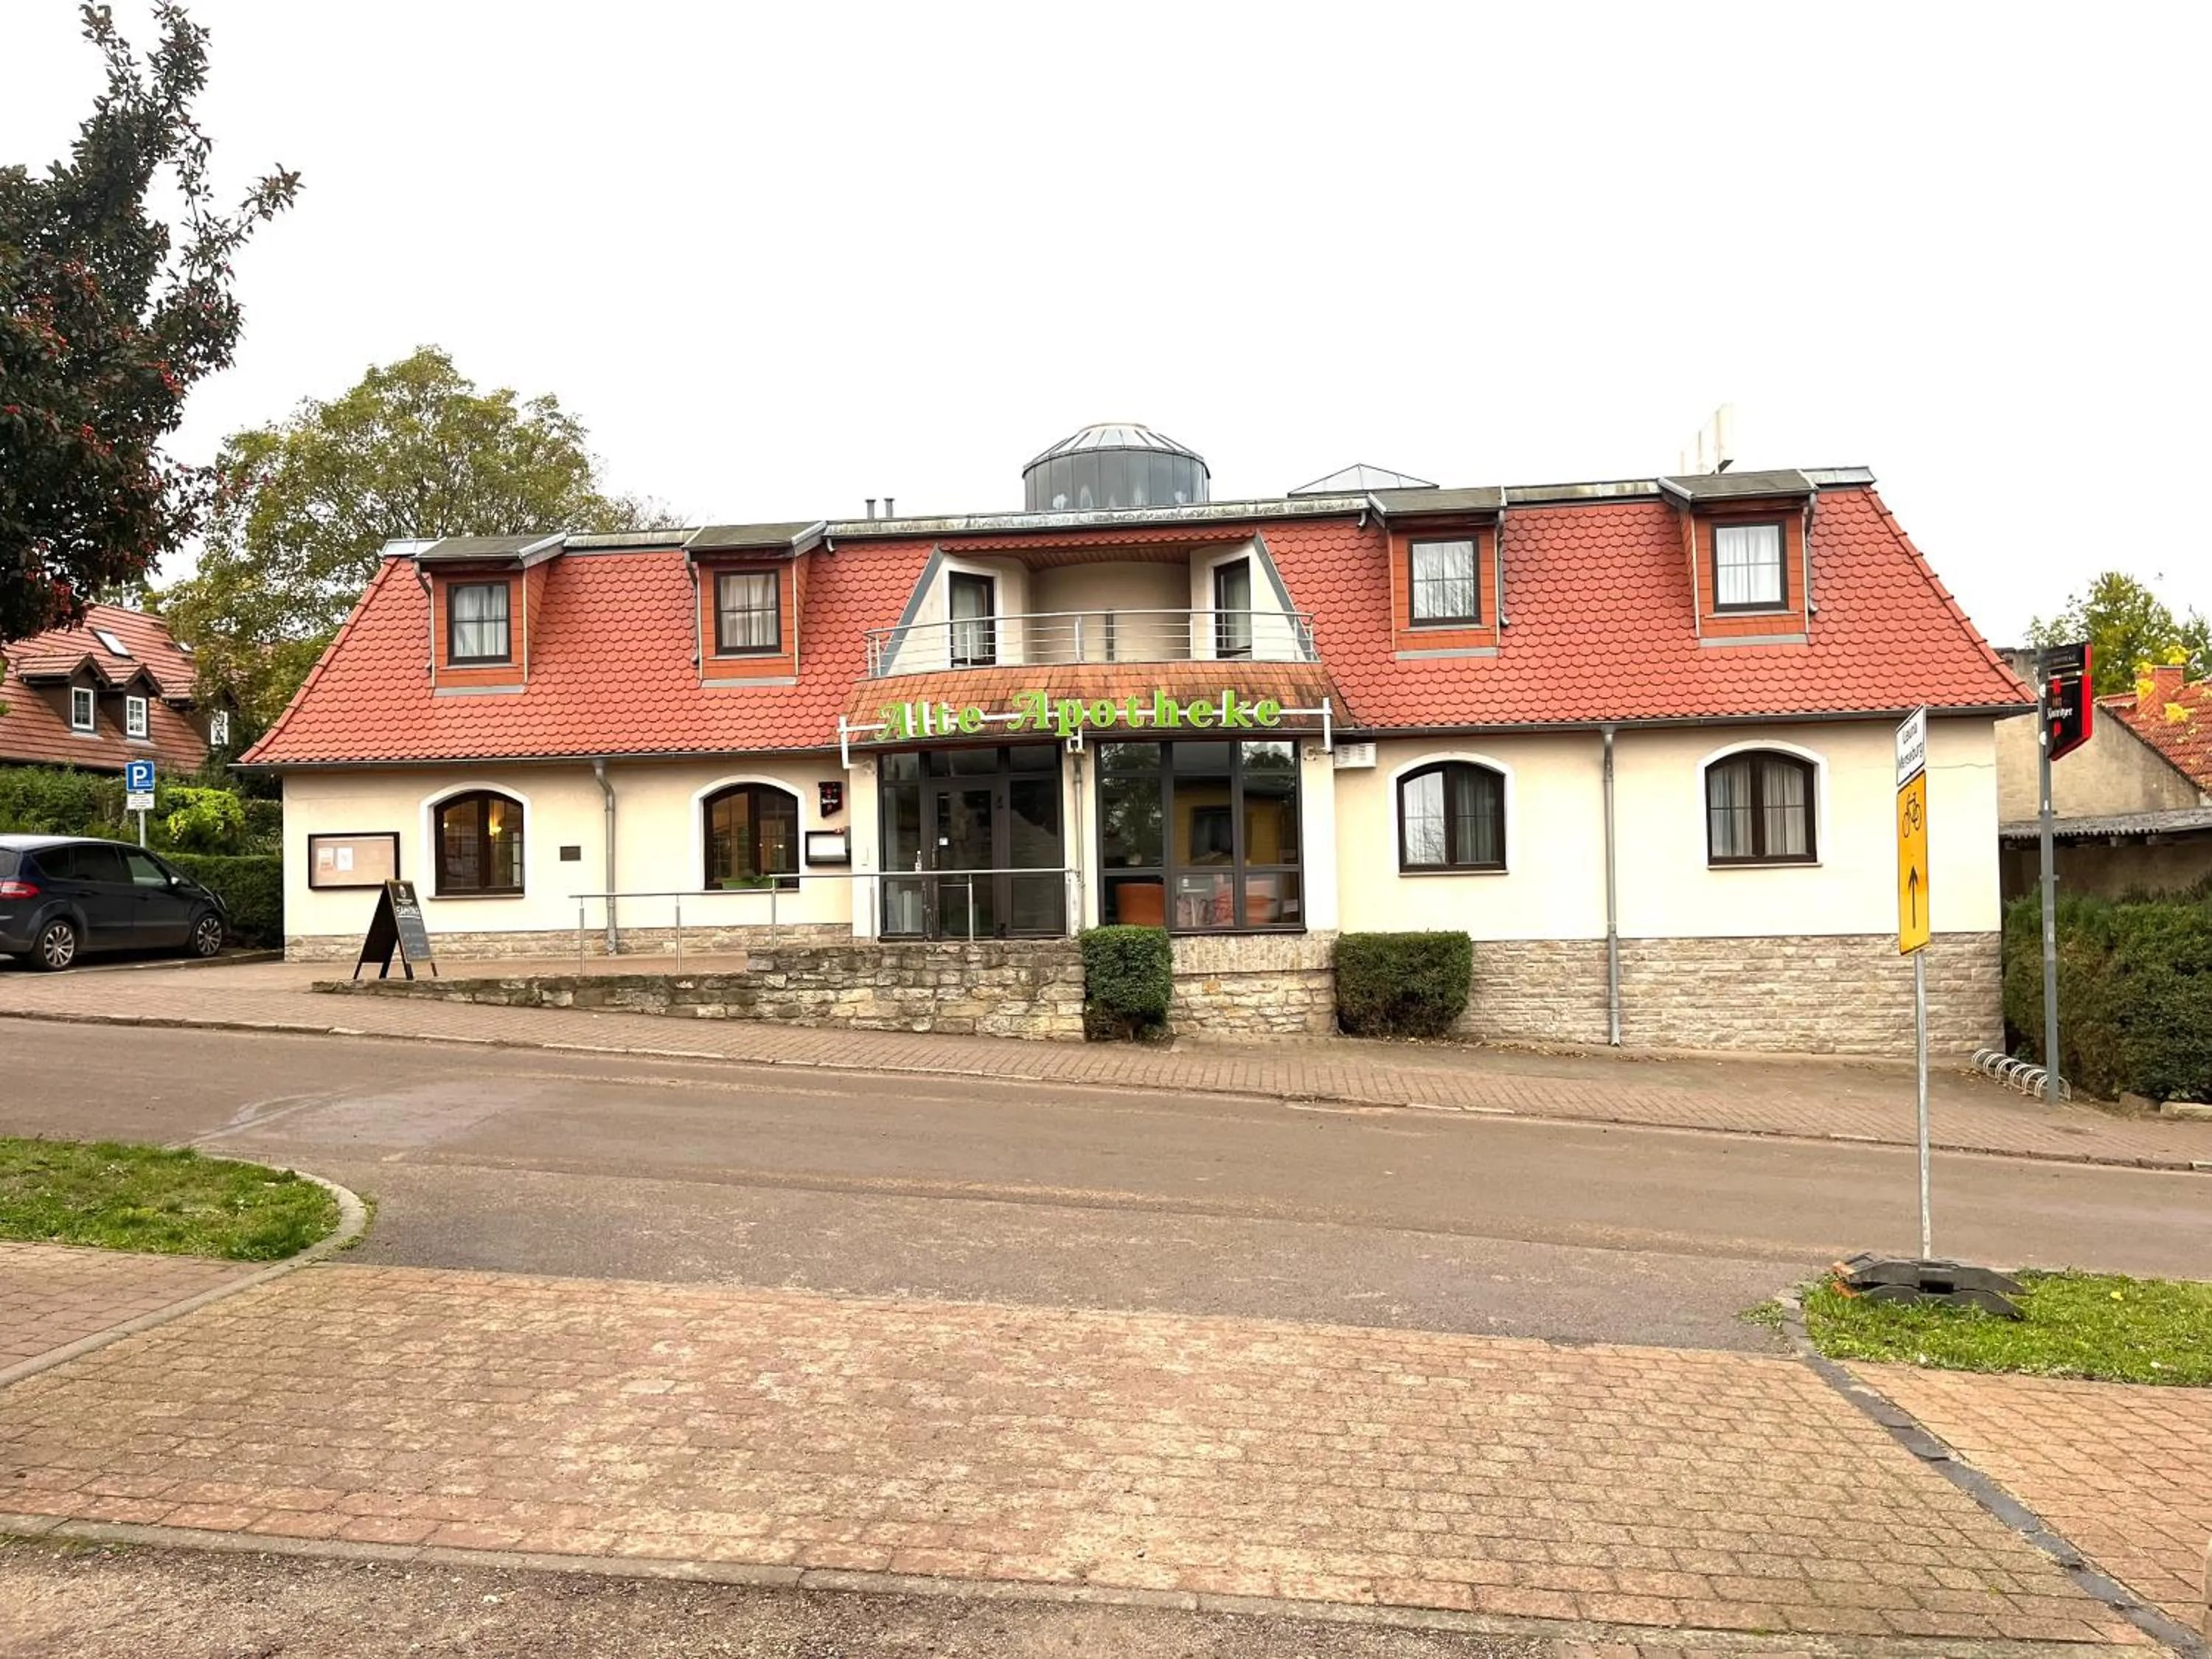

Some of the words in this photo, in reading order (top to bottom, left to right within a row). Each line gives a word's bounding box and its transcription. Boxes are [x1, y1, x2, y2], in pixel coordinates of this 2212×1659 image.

[874, 699, 985, 740] Alte
[1007, 689, 1281, 737] Apotheke
[133, 766, 147, 787] P
